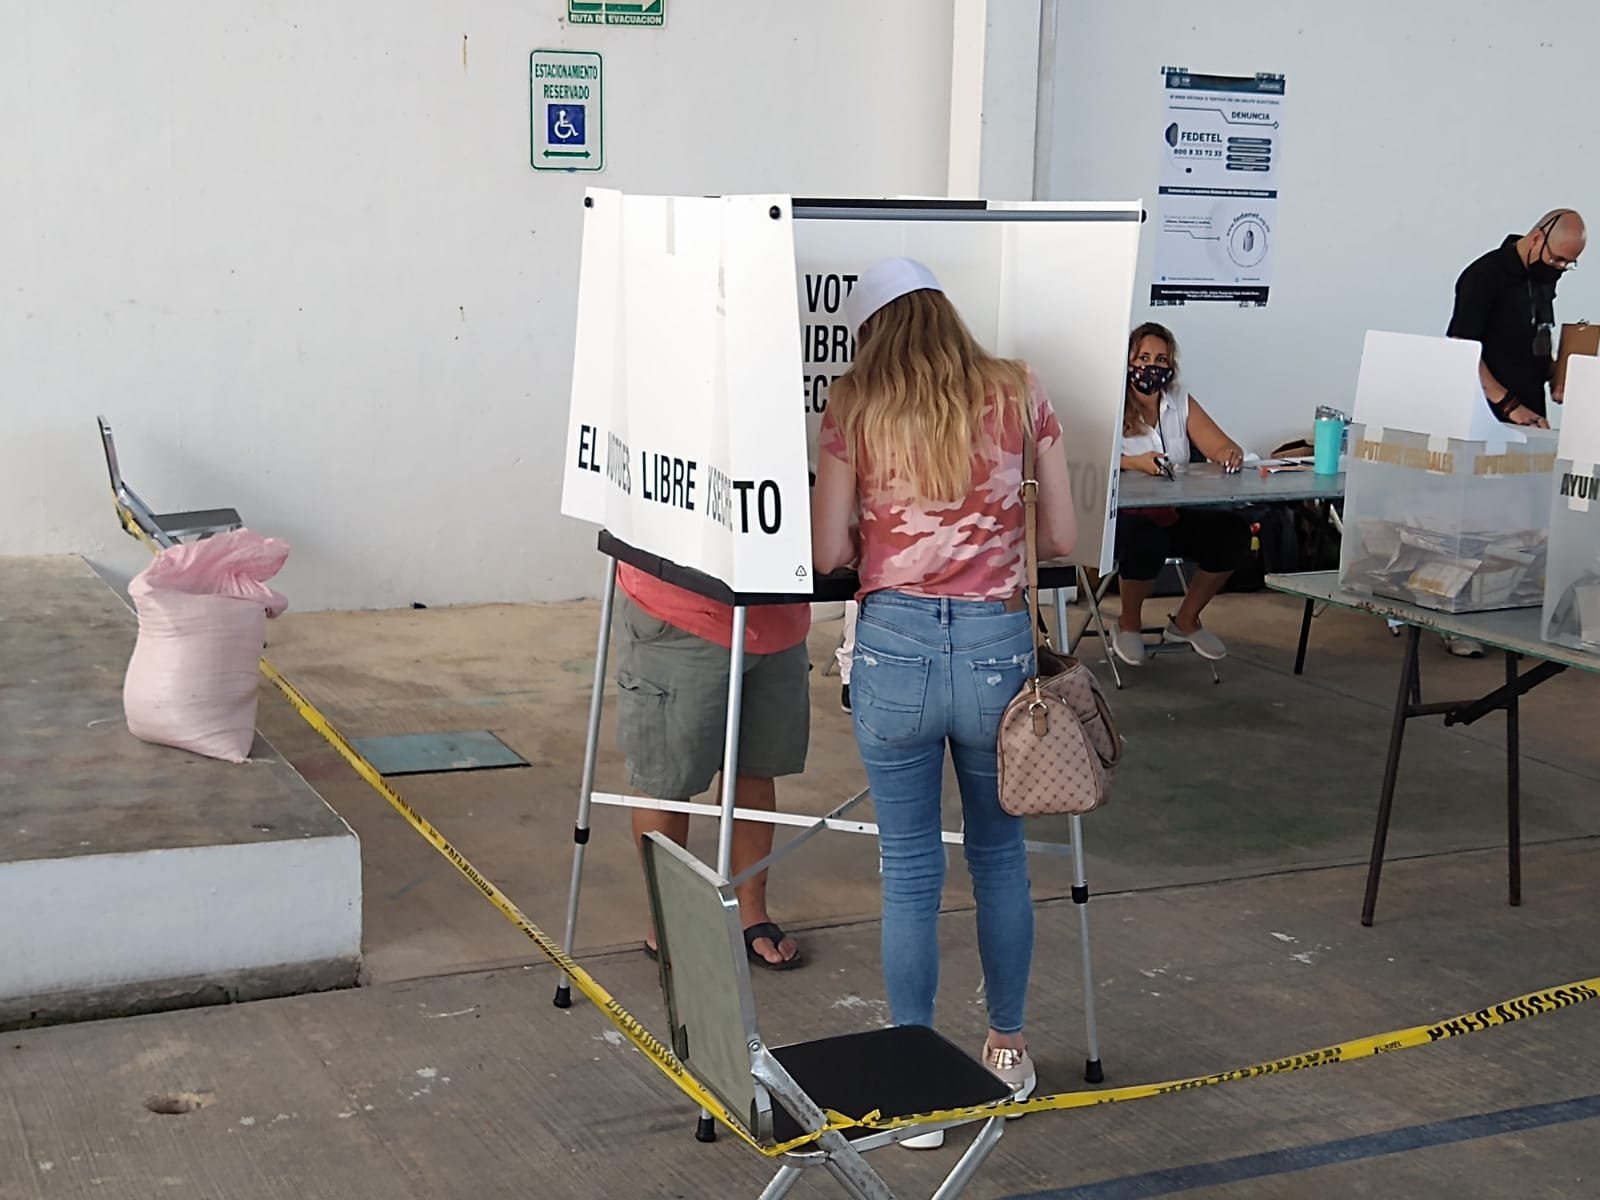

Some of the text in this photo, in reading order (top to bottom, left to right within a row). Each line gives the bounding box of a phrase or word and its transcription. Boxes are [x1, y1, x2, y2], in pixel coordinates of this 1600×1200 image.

[570, 14, 662, 25] RUTA DE EVACUACION
[535, 63, 598, 80] ESTACIONAMIENTO
[543, 84, 590, 100] RESERVADO
[1231, 111, 1271, 121] DENUNCIA
[1181, 131, 1223, 143] FEDETEL
[805, 274, 858, 314] VOT
[804, 325, 856, 363] IBR
[577, 424, 601, 473] EL
[641, 451, 698, 511] LIBRE
